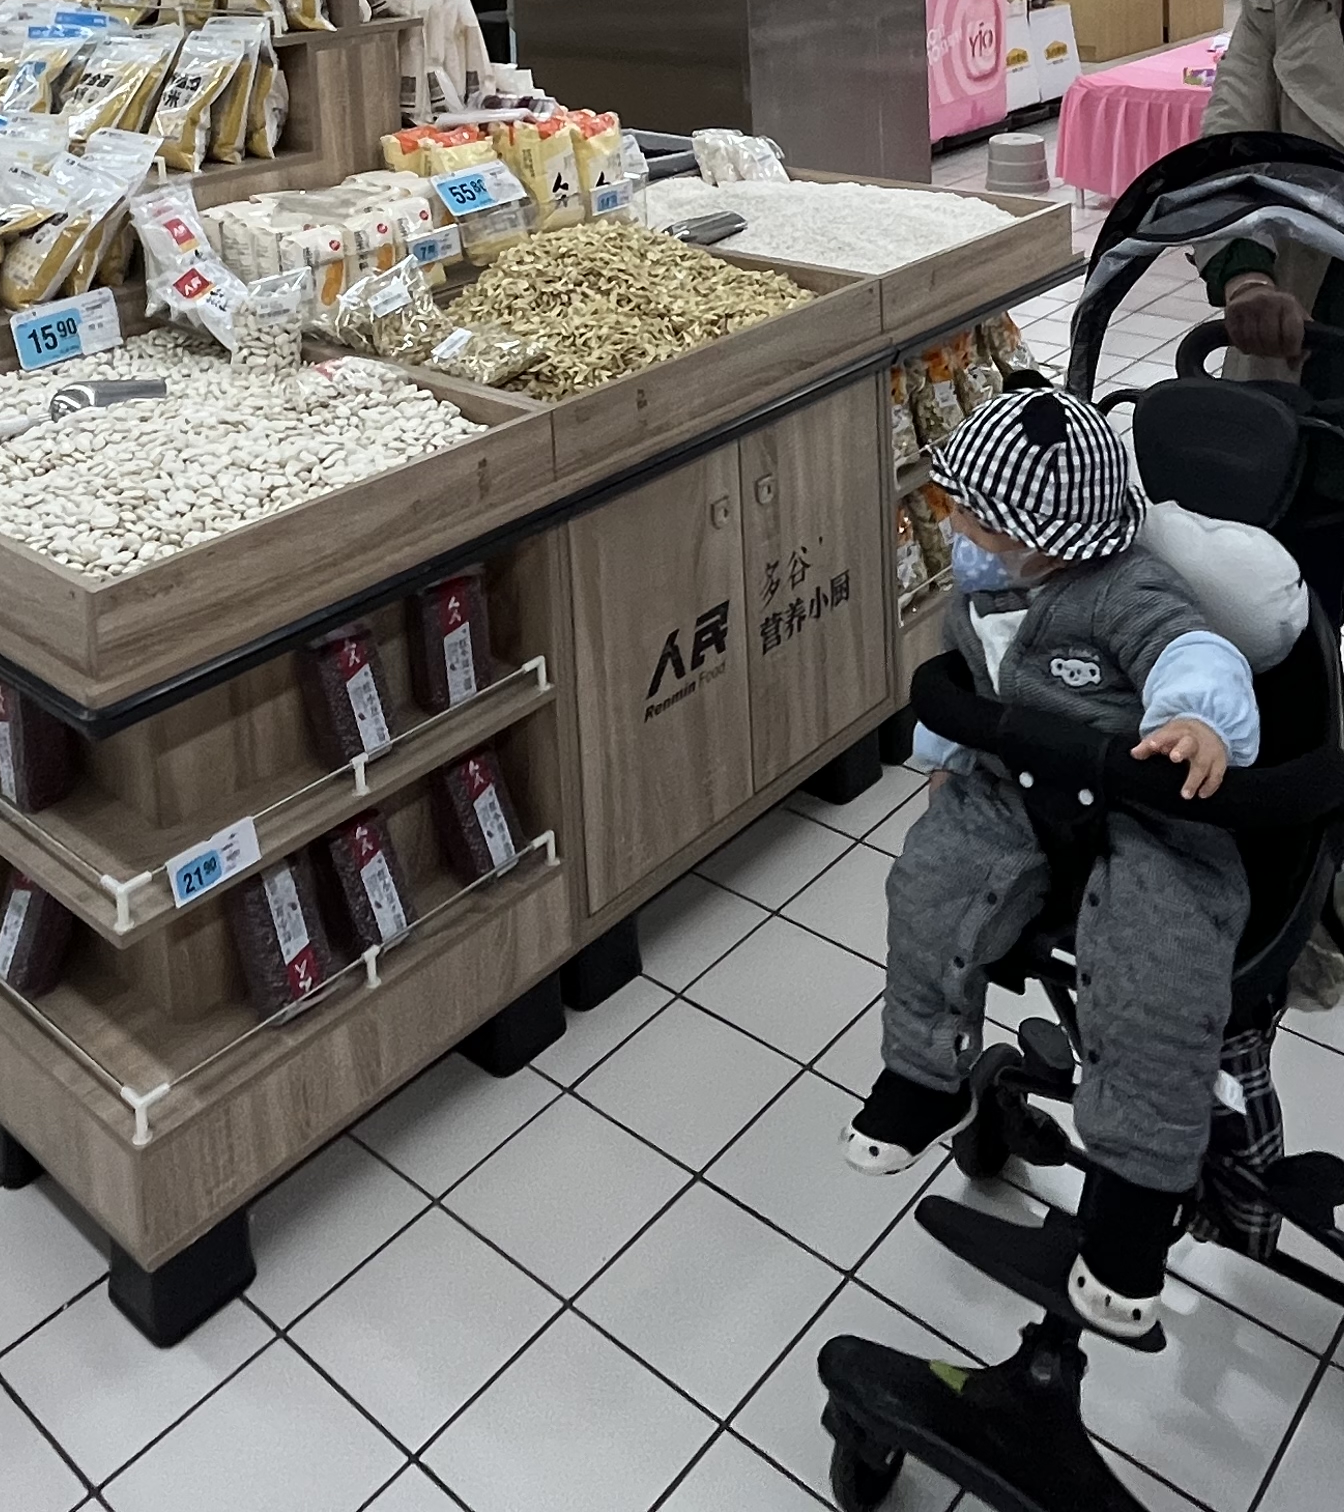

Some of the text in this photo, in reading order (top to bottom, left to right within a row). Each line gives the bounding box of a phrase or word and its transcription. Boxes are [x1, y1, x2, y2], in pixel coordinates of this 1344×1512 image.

[758, 567, 852, 657] 营养小厨
[643, 659, 728, 724] Renmin Food
